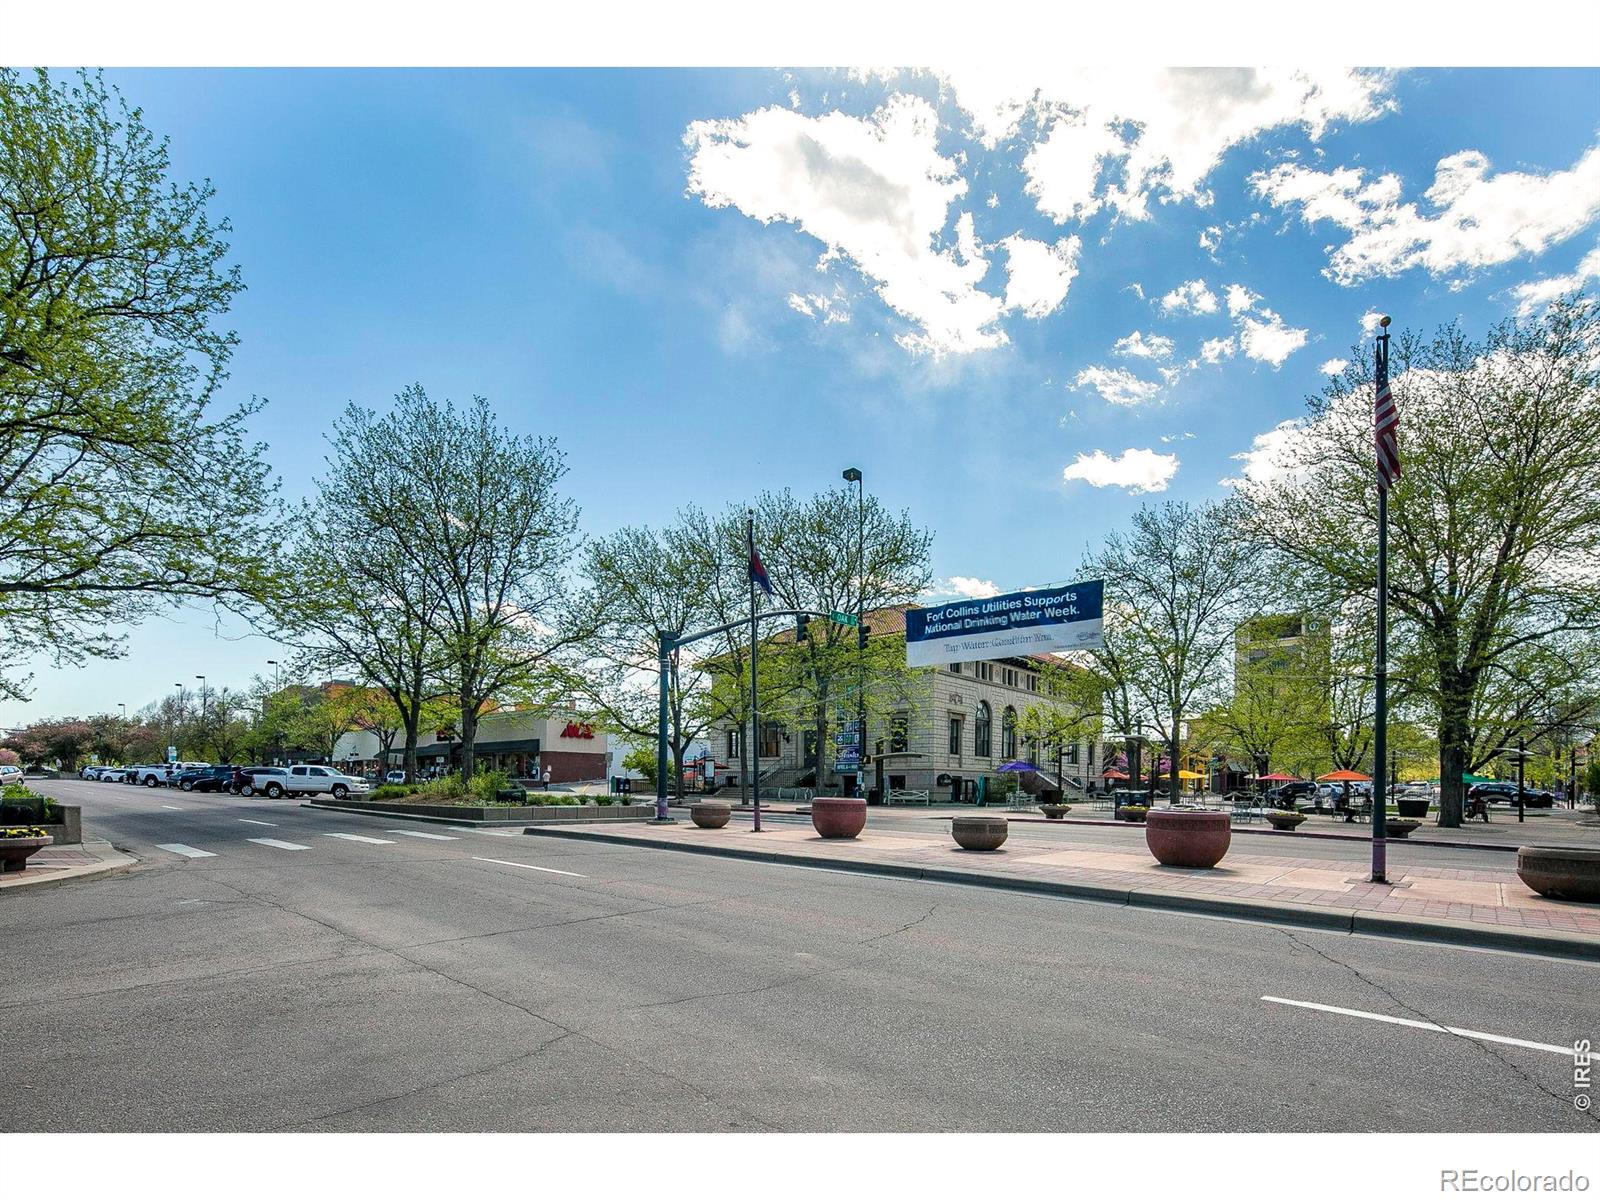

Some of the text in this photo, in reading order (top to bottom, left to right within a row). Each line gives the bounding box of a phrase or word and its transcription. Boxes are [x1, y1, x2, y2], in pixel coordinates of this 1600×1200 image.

[925, 605, 1080, 634] National Drinking Water Week.
[926, 592, 1077, 622] Fort Collins Utilities Supports
